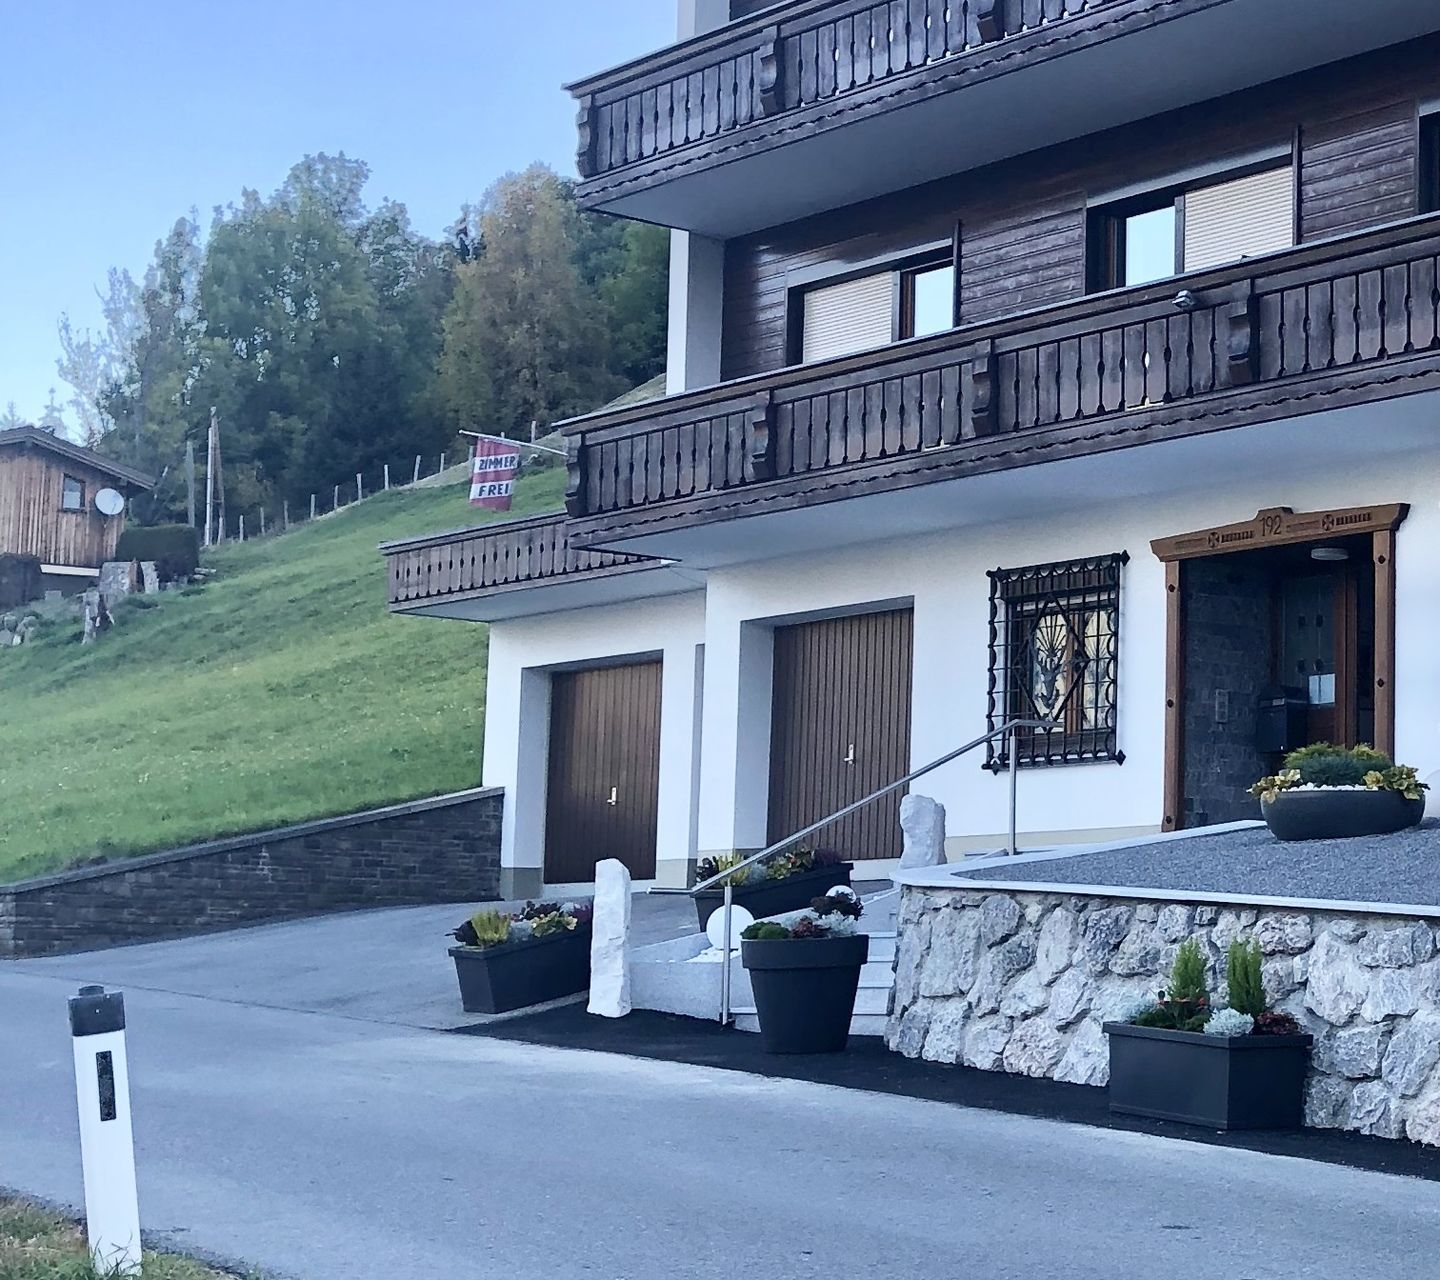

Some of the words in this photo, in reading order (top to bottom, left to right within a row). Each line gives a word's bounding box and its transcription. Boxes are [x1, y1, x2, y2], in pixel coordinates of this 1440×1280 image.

[479, 456, 516, 470] ZIMMER
[478, 483, 509, 496] FREI
[1260, 515, 1282, 537] 192
